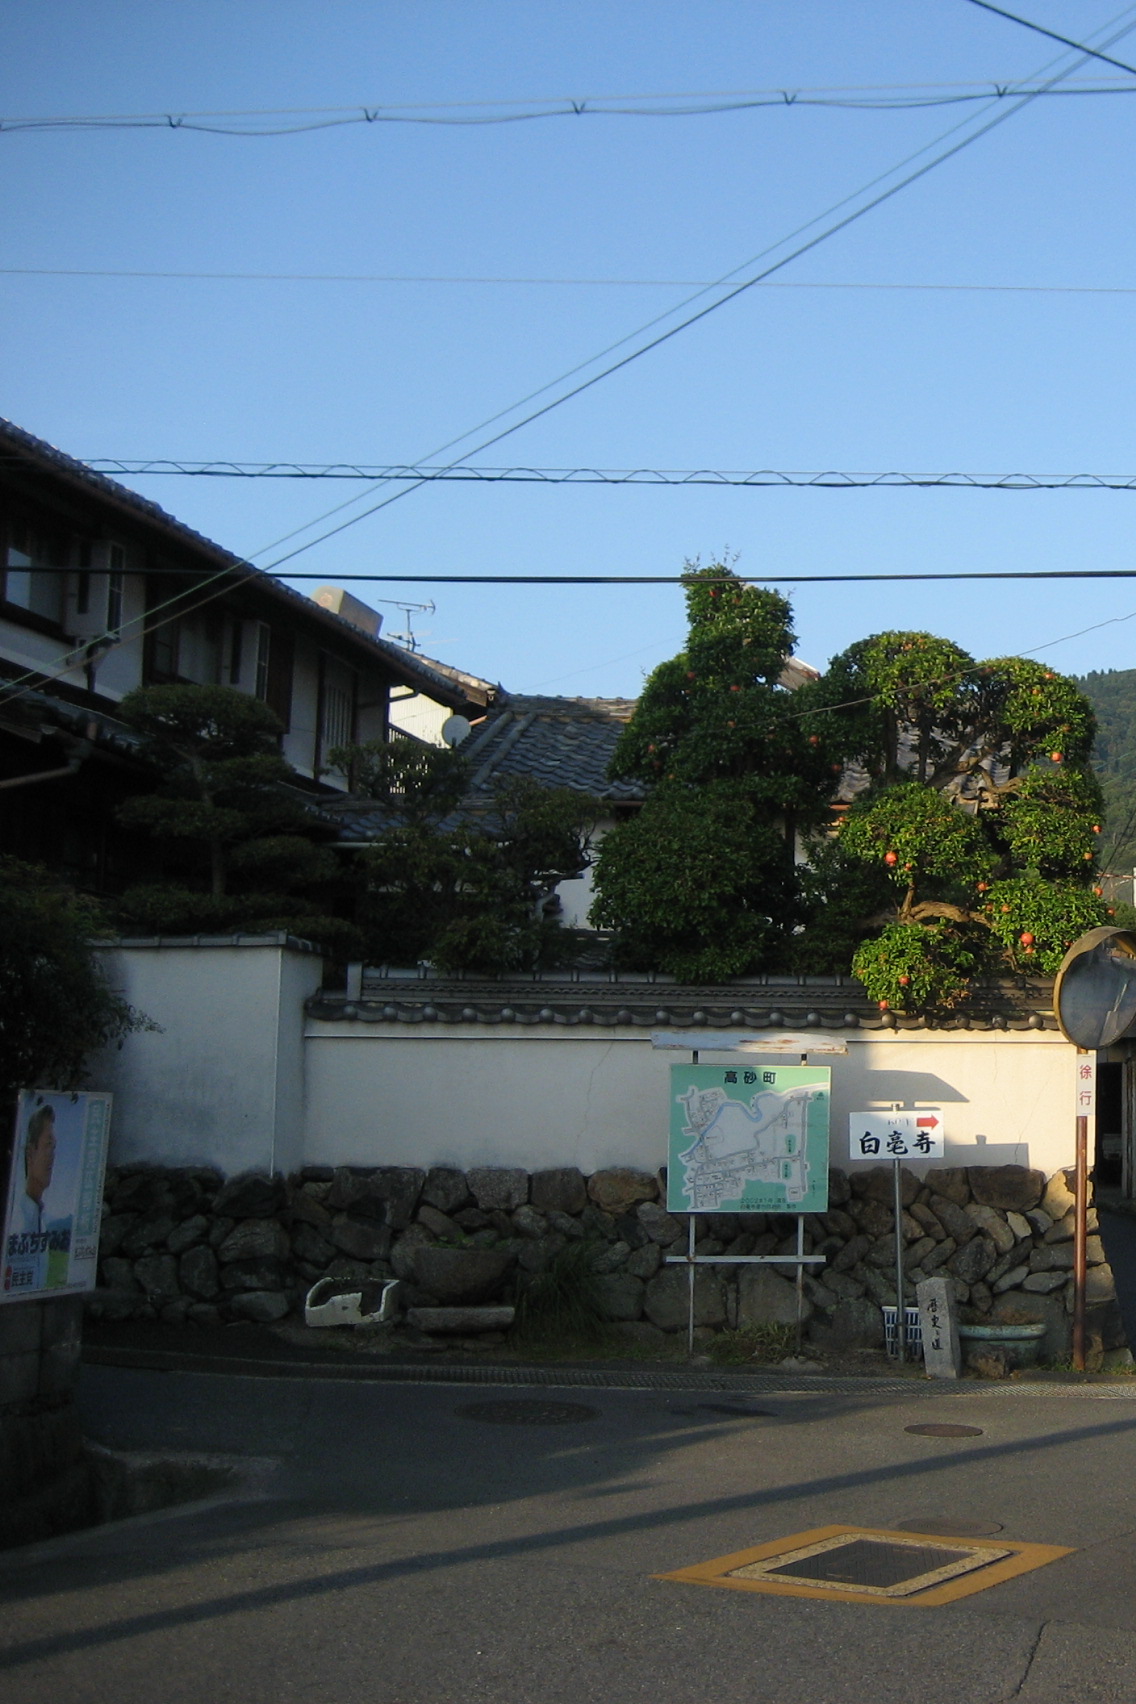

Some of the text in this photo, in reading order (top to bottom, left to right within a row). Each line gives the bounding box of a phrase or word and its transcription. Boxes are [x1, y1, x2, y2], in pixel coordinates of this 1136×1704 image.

[724, 1070, 777, 1085] 高砂町
[1079, 1064, 1092, 1106] 徐行
[859, 1130, 936, 1155] 白毫寺
